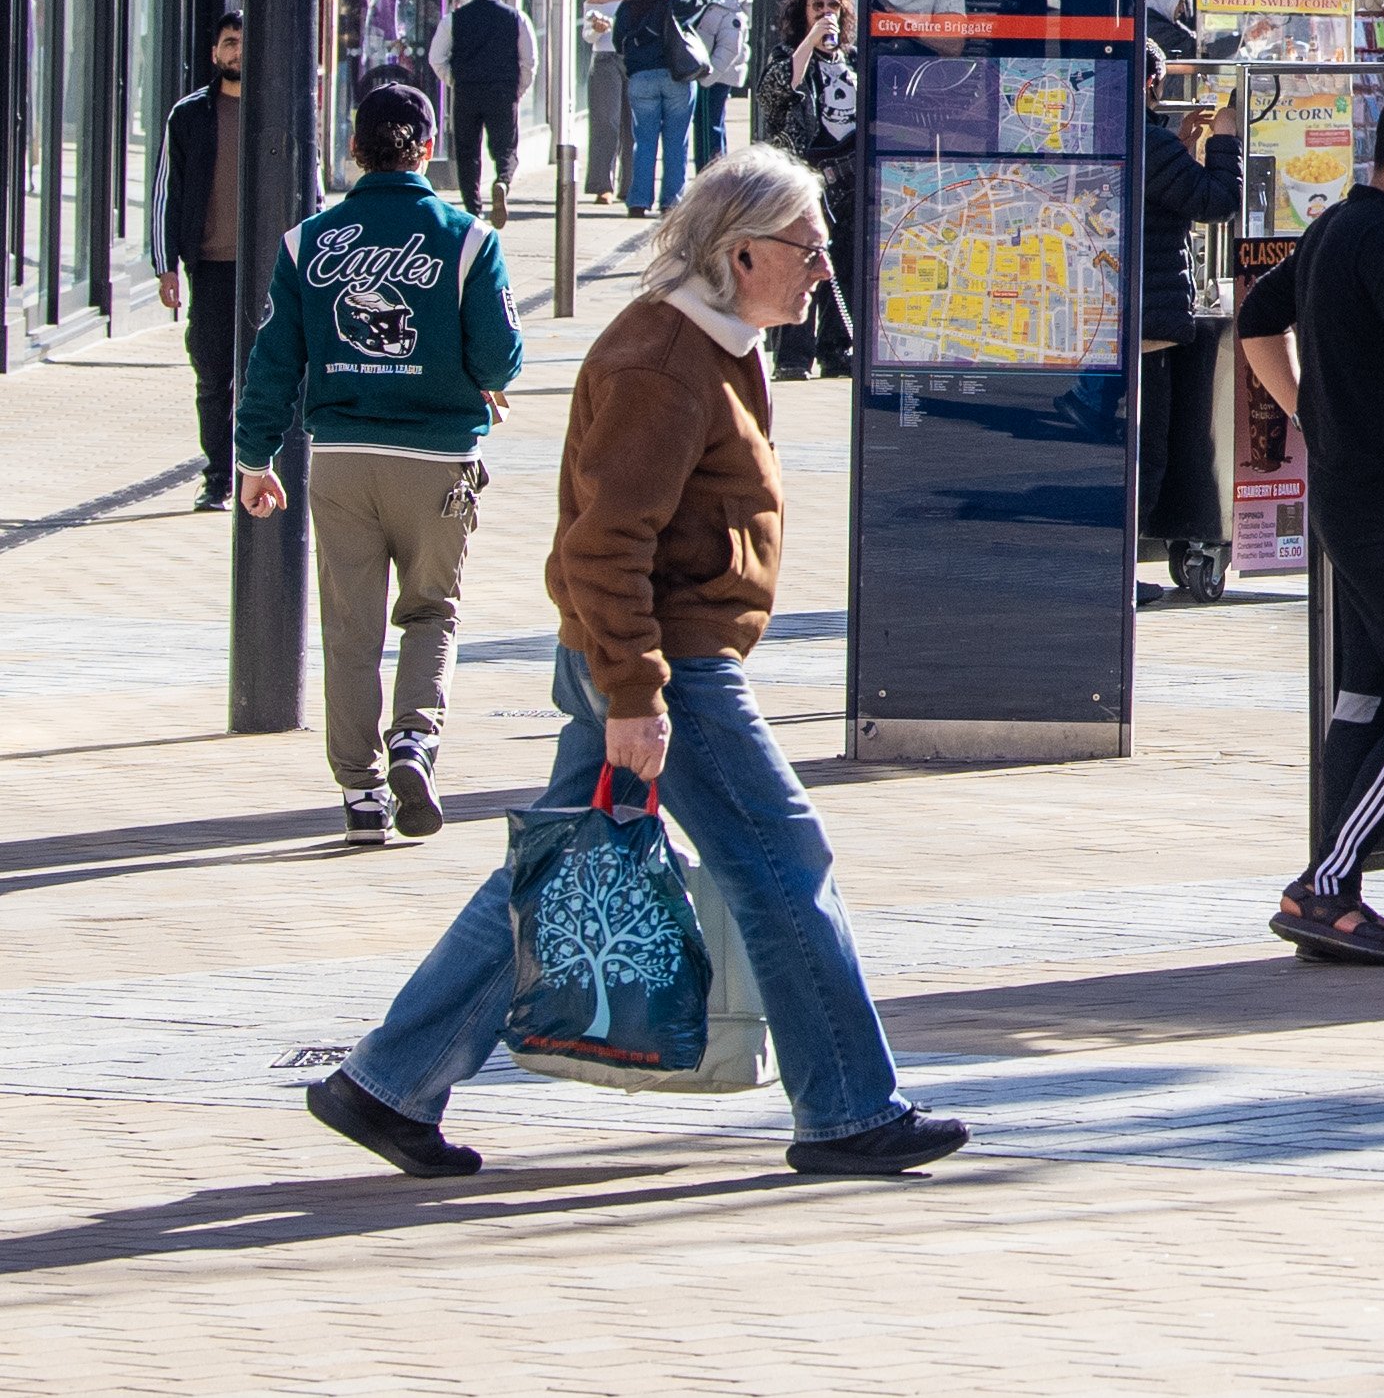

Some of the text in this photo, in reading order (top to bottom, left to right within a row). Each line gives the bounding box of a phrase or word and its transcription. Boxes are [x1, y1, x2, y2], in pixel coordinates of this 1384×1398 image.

[878, 20, 993, 35] City Centre Briggate
[1285, 108, 1333, 121] CORN
[306, 223, 443, 294] Eagles
[360, 364, 423, 375] FOOTBALL LEAGUE
[1236, 483, 1300, 498] STRAWBERRY BANANA
[1280, 546, 1302, 557] £5.00
